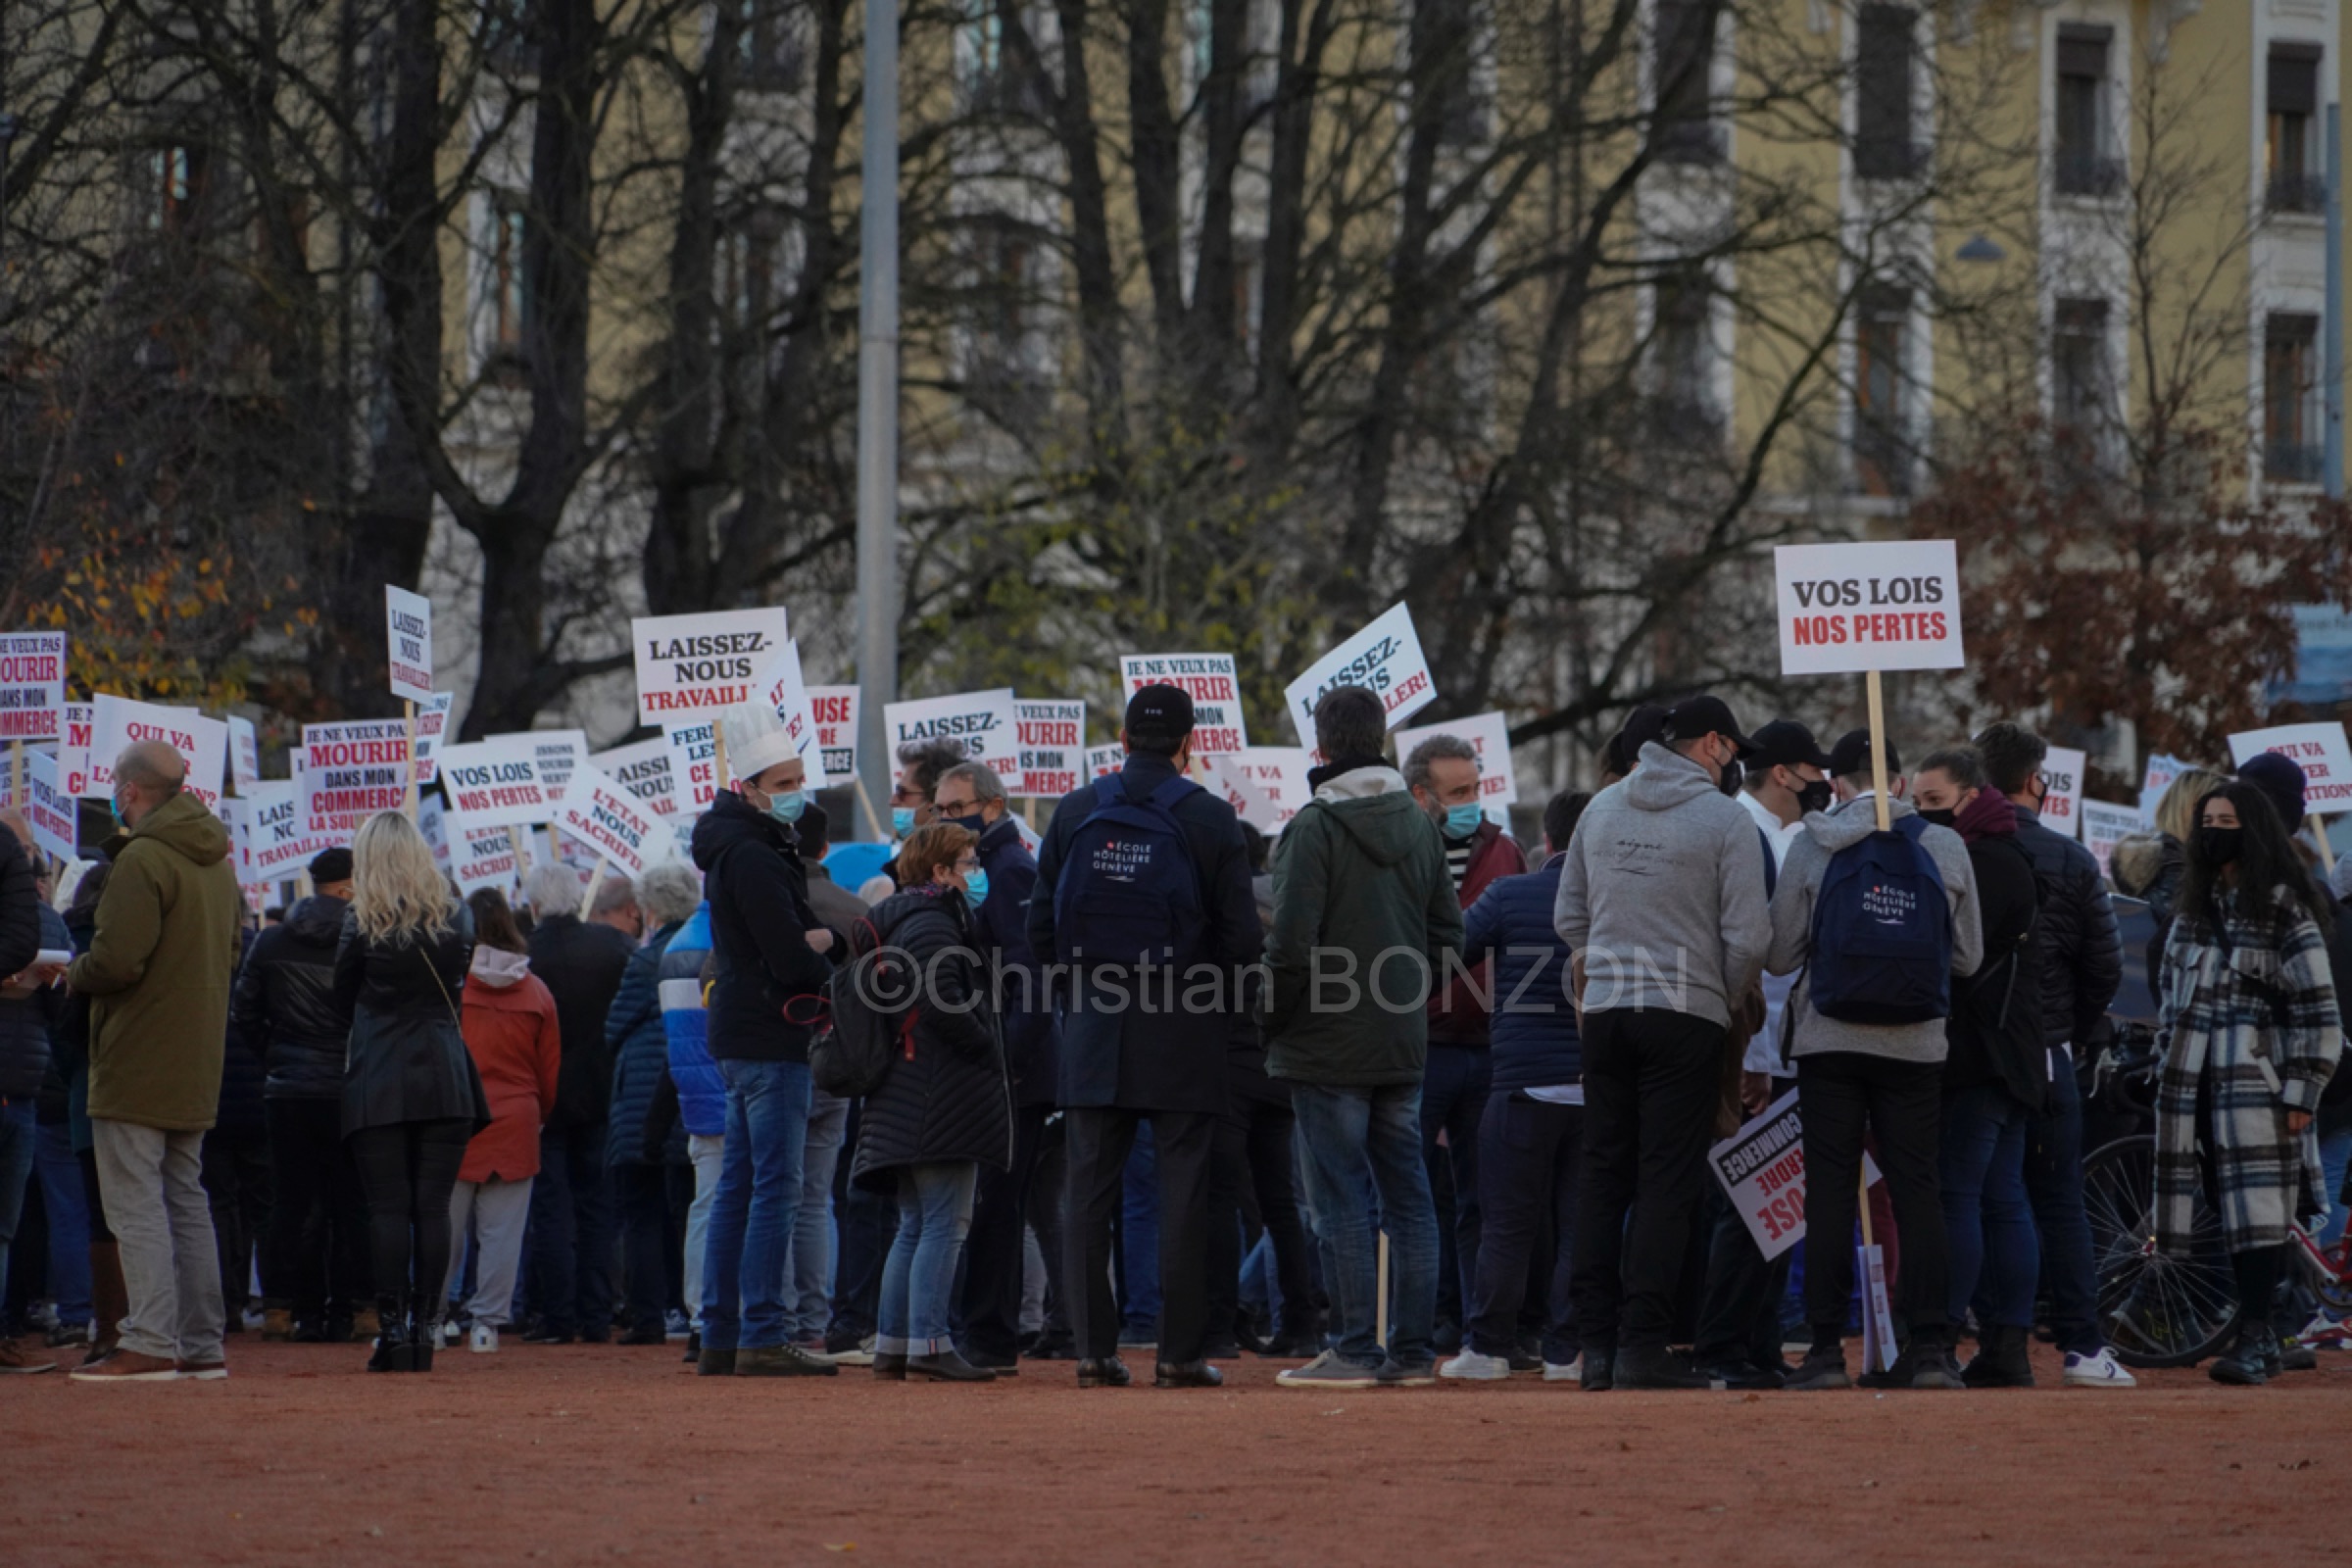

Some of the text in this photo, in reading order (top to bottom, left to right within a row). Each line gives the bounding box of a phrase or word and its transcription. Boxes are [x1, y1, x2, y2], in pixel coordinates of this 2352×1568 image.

[1791, 576, 1943, 608] VOS LOIS
[1793, 612, 1947, 646] NOS PERTES
[40, 637, 61, 654] PAS
[649, 631, 773, 661] LAISSEZ-
[0, 656, 59, 683] OURIR
[674, 658, 753, 682] NOUS
[1127, 658, 1232, 676] JE NE VEUX PAS
[1020, 704, 1081, 720] VEUX PAS
[322, 727, 342, 742] NE
[344, 725, 384, 741] VEUX
[386, 723, 407, 738] PA
[898, 710, 1003, 742] LAISSEZ-
[171, 730, 195, 752] VA
[2300, 742, 2327, 758] VA
[1037, 751, 1064, 768] MON
[325, 769, 361, 788] DANS
[365, 767, 396, 786] MON
[450, 766, 491, 787] VOS
[492, 762, 533, 783] LOIS
[1257, 765, 1283, 779] VA
[312, 787, 406, 814] COMMERC
[457, 790, 491, 811] NOS
[491, 785, 543, 808] PERTES
[592, 805, 642, 851] NOUS
[1116, 841, 1152, 854] ÉCOLE
